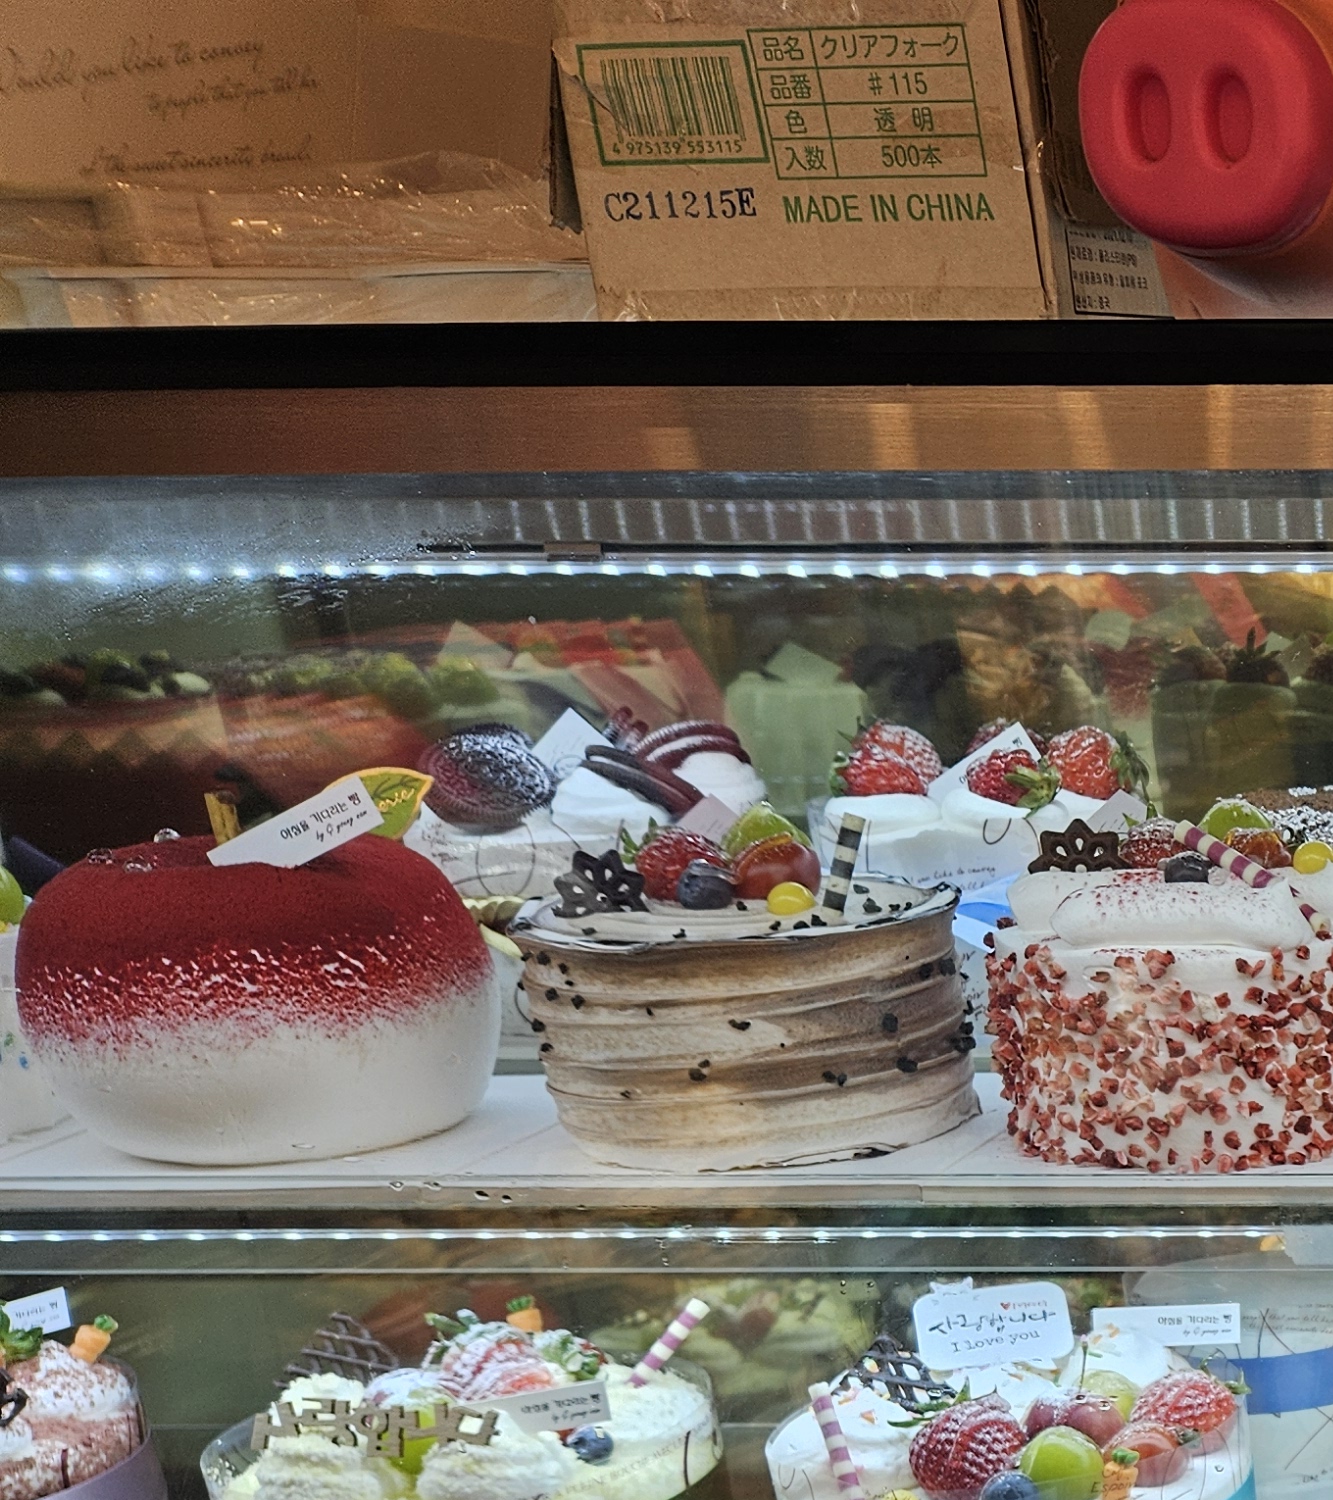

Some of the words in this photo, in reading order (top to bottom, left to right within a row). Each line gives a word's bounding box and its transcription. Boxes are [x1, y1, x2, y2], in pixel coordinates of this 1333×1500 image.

[763, 36, 806, 62] 品名
[819, 32, 961, 60] クリアフォーク
[769, 74, 813, 101] 品番
[785, 109, 808, 135] 色
[626, 141, 681, 155] 975139
[687, 138, 743, 155] 553115
[784, 145, 828, 172] 入数
[881, 144, 944, 169] 500本
[603, 186, 758, 222] C211215E
[782, 194, 863, 224] MADE
[872, 193, 899, 222] IN
[906, 192, 996, 222] CHINA
[279, 820, 311, 841] 아침을
[309, 800, 349, 822] 기다리는
[347, 791, 362, 805] 빵
[928, 1309, 1057, 1335] 사랑합니다
[951, 1342, 961, 1353] I
[967, 1335, 1005, 1351] love
[1009, 1330, 1040, 1346] you
